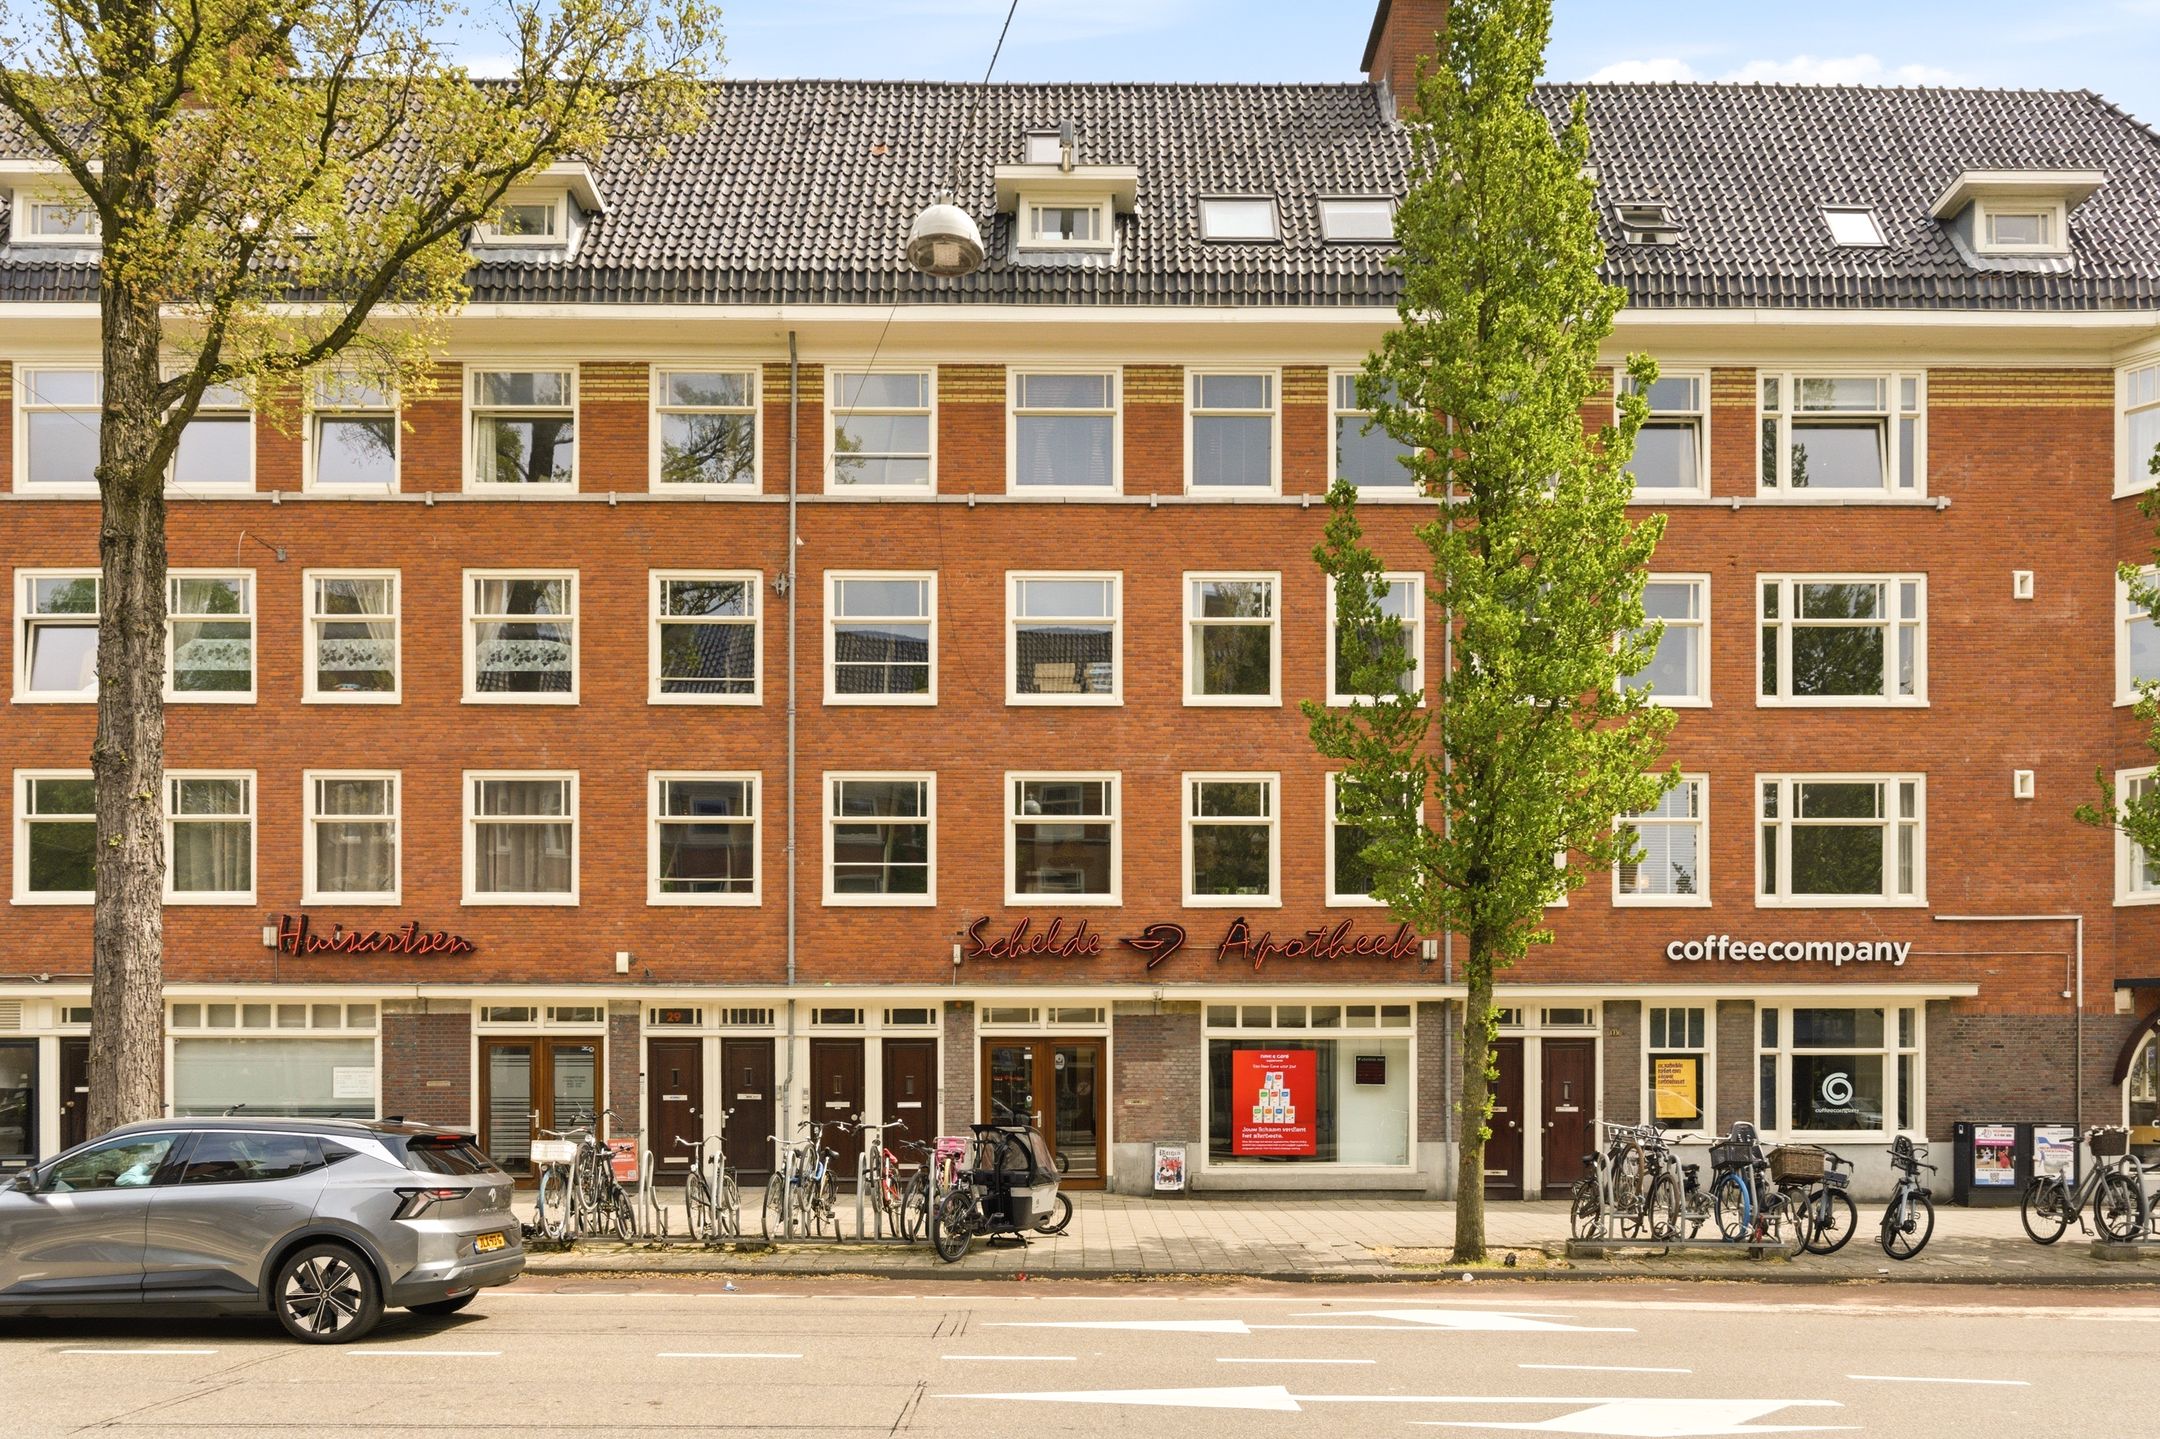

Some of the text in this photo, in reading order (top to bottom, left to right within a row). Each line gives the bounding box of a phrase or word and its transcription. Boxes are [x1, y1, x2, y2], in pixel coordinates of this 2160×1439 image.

[278, 914, 474, 956] Huisartsen
[968, 916, 1416, 969] Schelde Apotheek
[1667, 935, 1912, 966] coffeecompany
